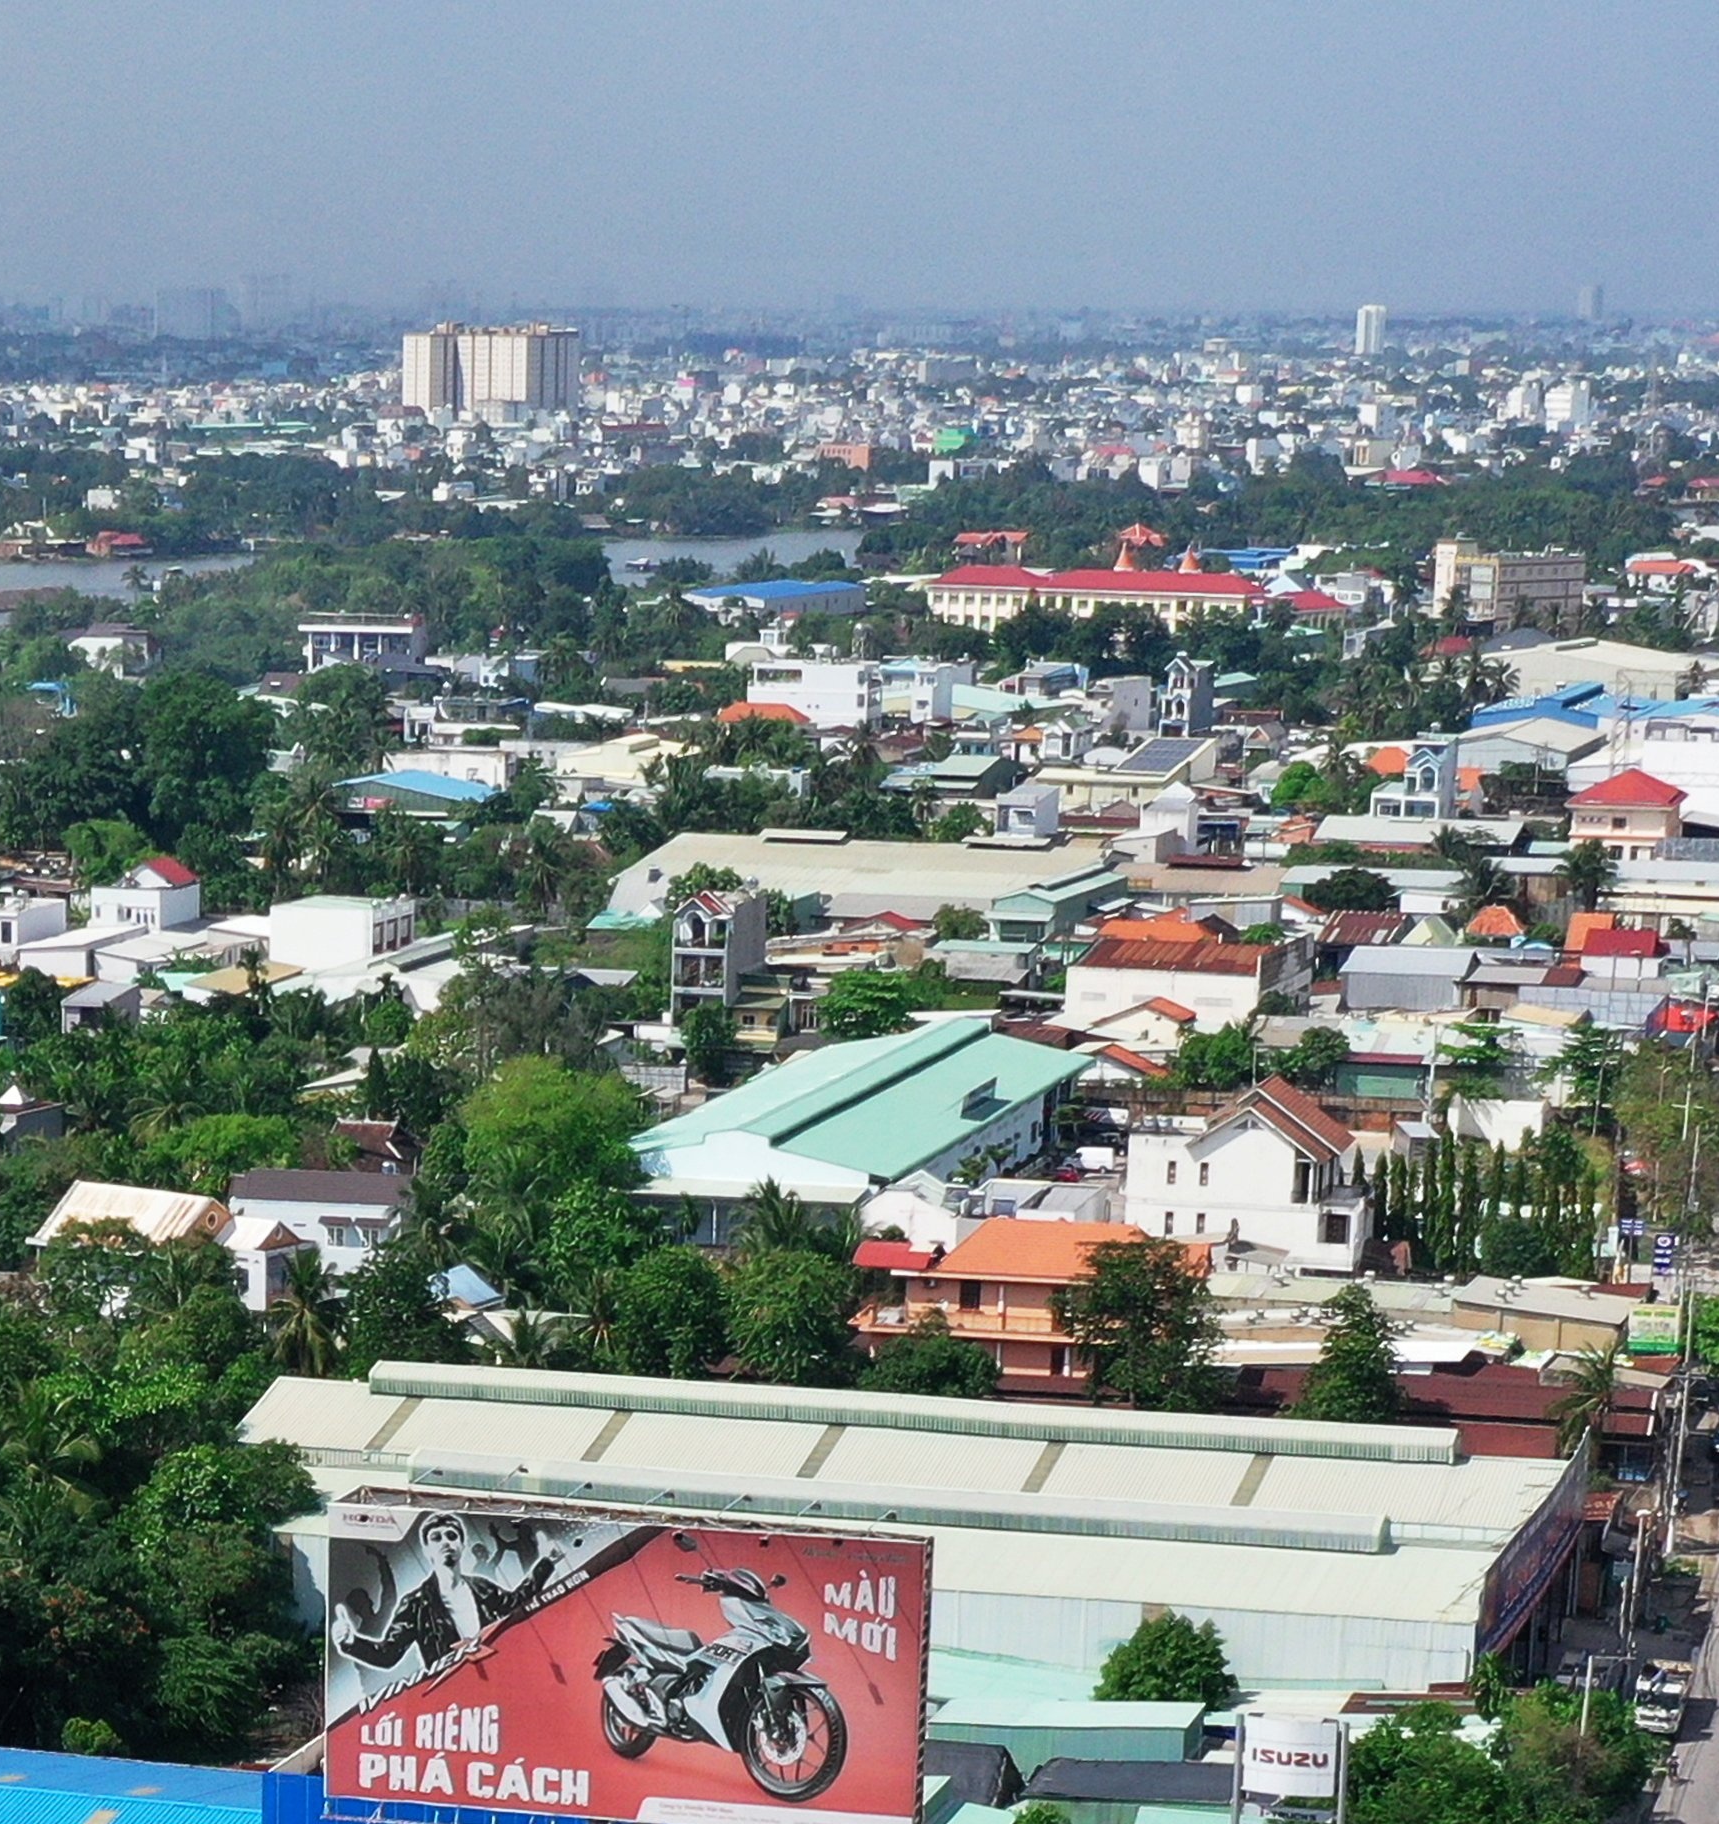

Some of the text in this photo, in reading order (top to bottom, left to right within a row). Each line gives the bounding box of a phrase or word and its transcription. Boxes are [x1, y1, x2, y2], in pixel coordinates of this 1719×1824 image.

[342, 1513, 396, 1525] HONDA
[824, 1569, 896, 1619] MÀU
[823, 1612, 897, 1662] MỚI
[361, 1703, 499, 1756] LỐI RIÊNG
[358, 1751, 590, 1807] PHÁ CÁCH
[1253, 1747, 1329, 1768] ISUZU
